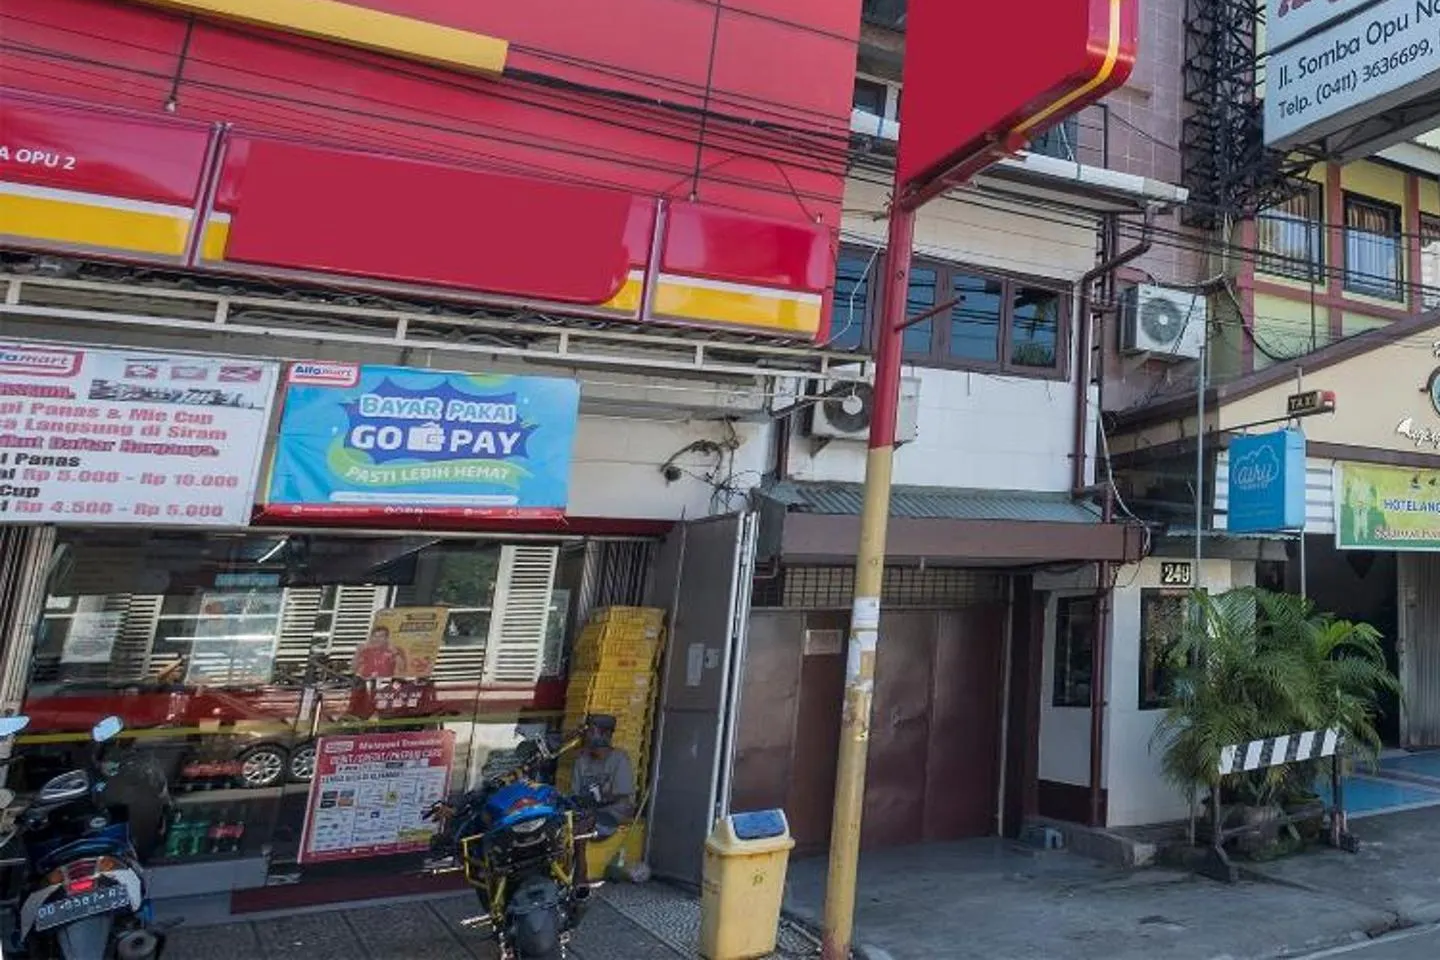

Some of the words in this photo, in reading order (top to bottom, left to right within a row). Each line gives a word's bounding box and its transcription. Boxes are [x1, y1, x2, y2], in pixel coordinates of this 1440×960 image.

[1278, 64, 1293, 91] Jl.
[1299, 37, 1362, 81] Somba
[1366, 16, 1409, 45] Opu
[1278, 95, 1313, 119] Telp.
[1316, 69, 1358, 106] (0411)
[1362, 40, 1435, 83] 3636699,
[16, 148, 60, 168] OPU
[62, 156, 77, 171] 2
[359, 393, 442, 420] BAYAR
[446, 398, 517, 424] PAKAI
[350, 424, 401, 451] GO
[450, 429, 521, 454] PAY
[14, 452, 81, 468] Panas
[345, 465, 396, 484] PASTI
